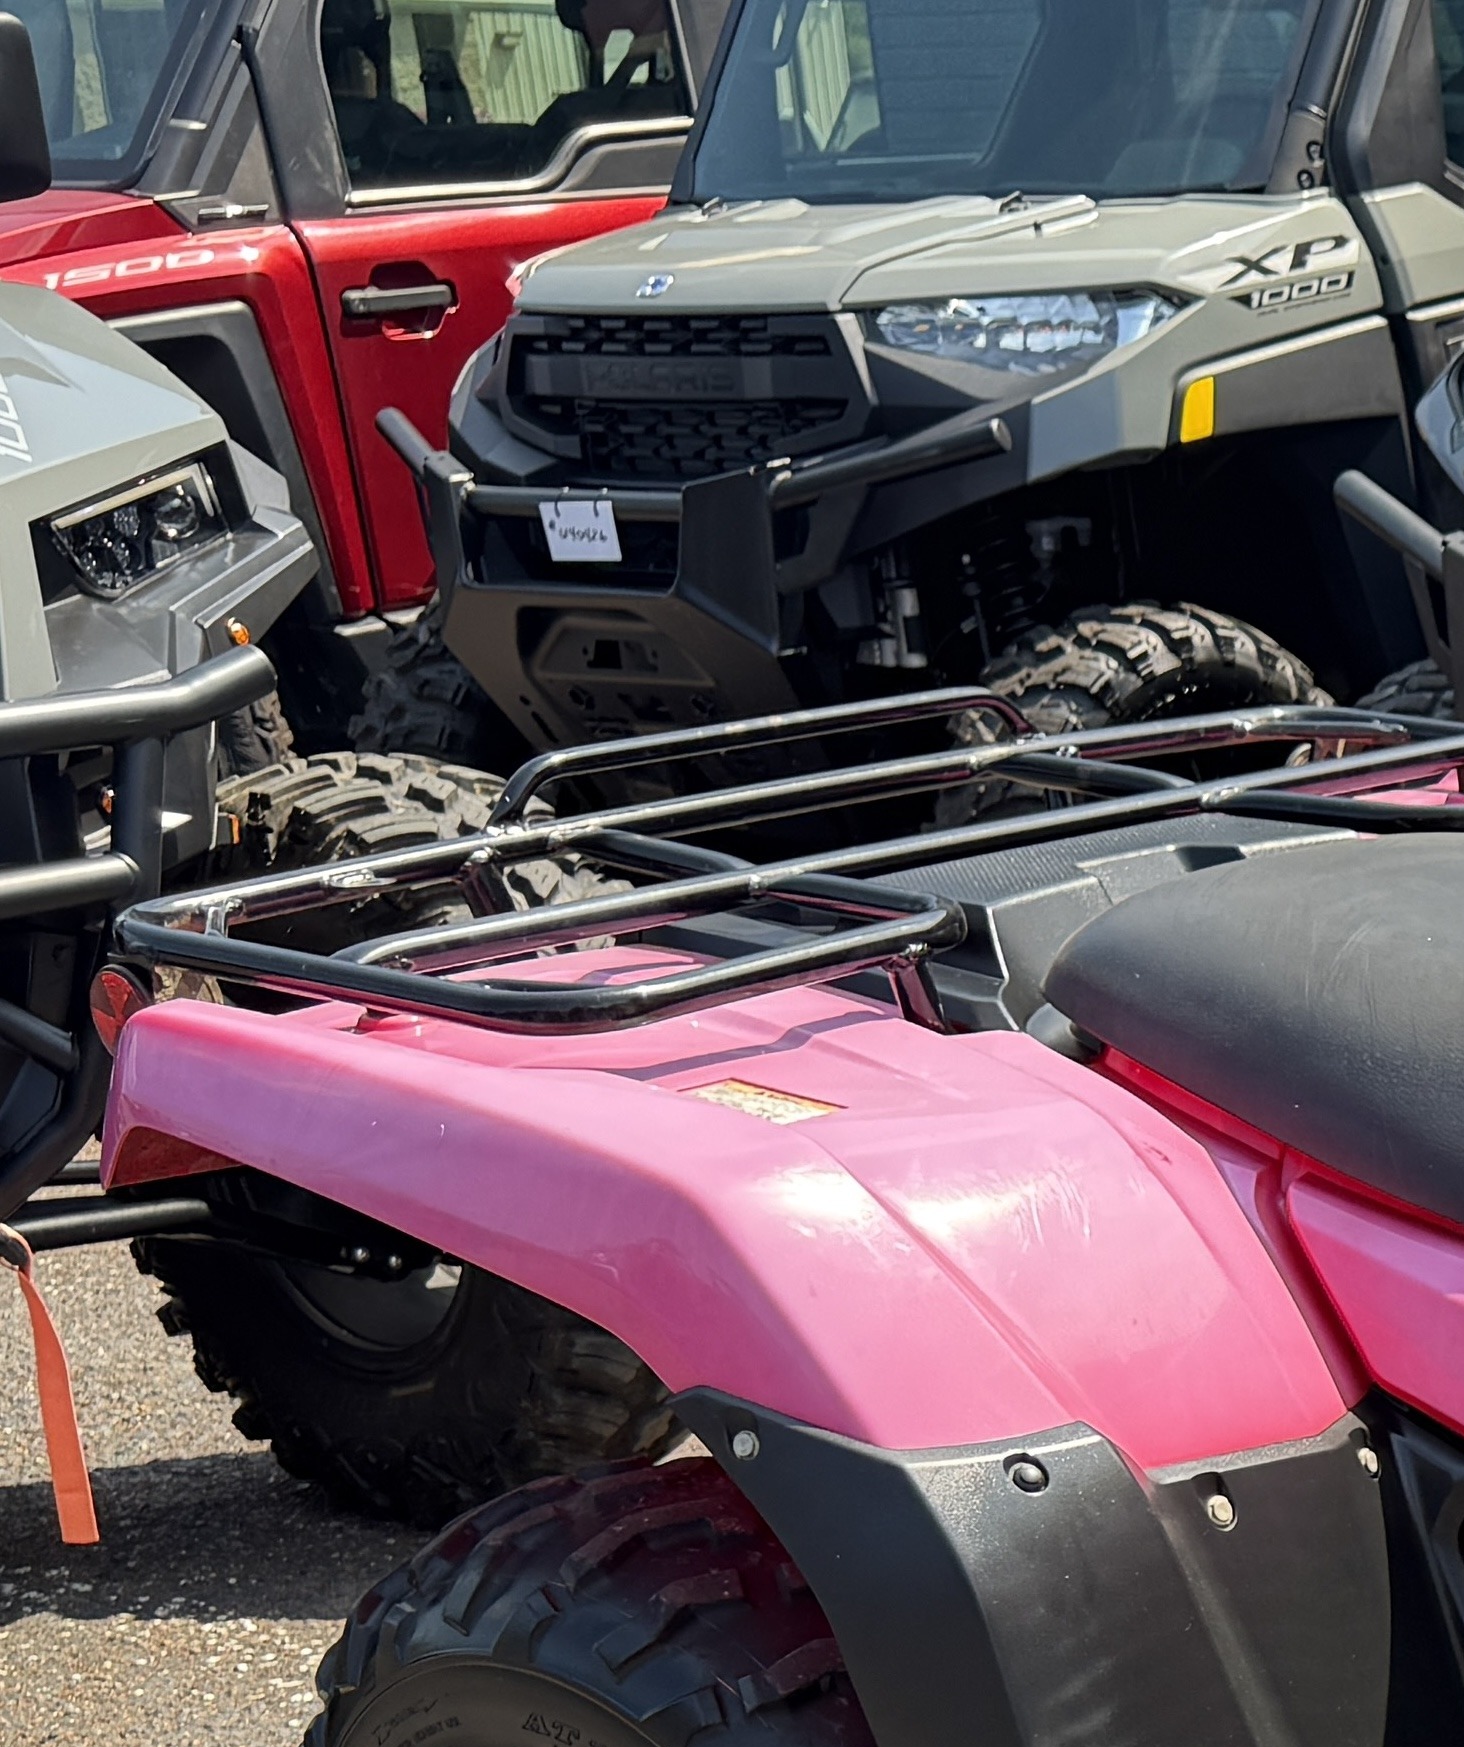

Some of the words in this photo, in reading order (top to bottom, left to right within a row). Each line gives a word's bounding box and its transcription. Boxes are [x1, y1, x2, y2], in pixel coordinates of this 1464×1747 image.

[43, 249, 215, 290] 1500
[1217, 234, 1350, 288] XP
[1250, 272, 1349, 310] 1000
